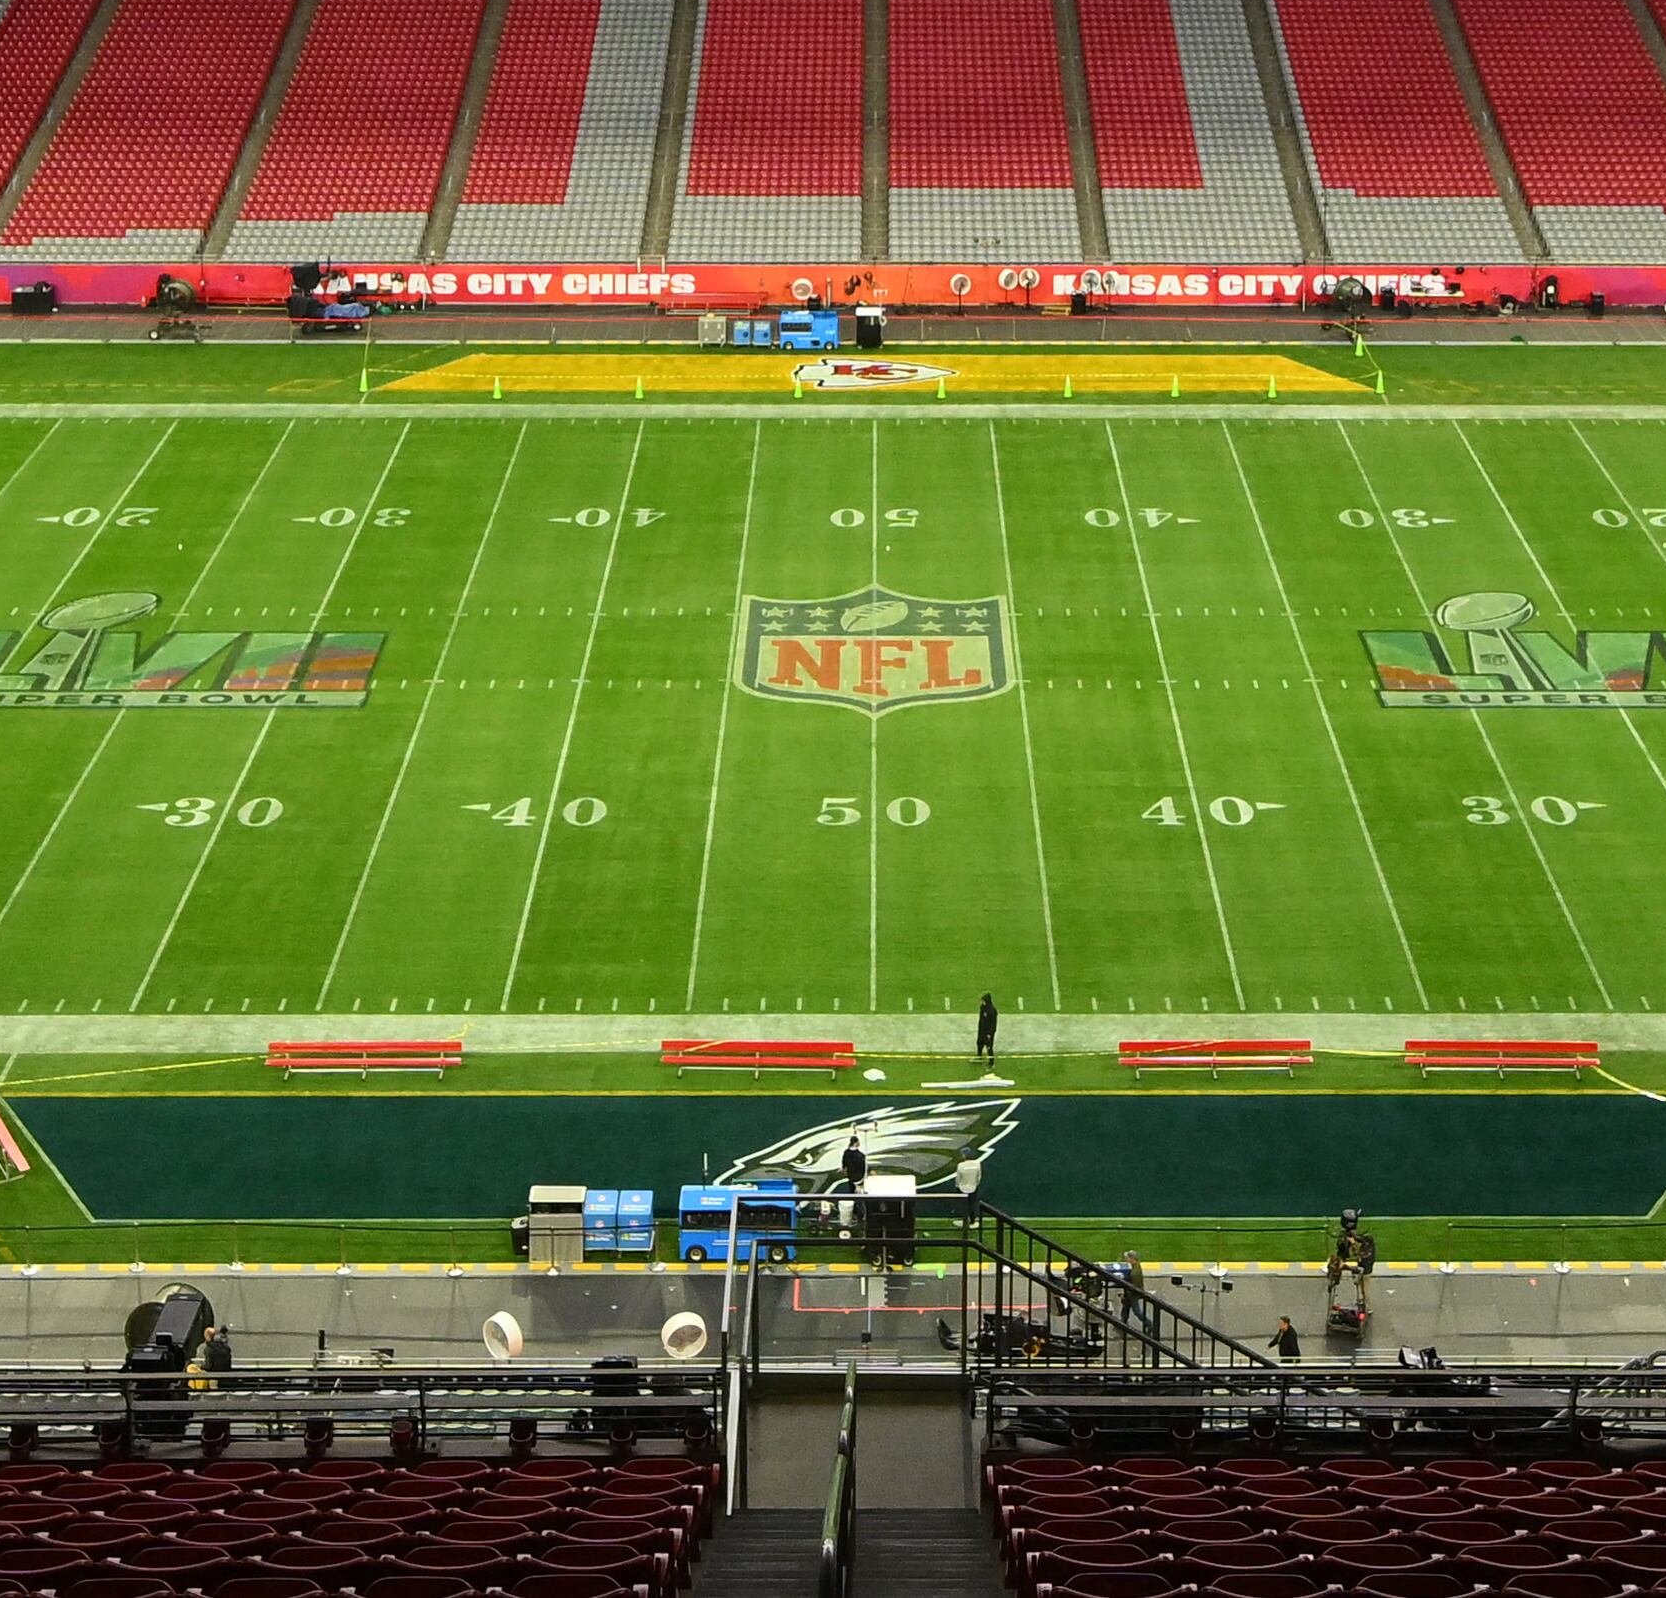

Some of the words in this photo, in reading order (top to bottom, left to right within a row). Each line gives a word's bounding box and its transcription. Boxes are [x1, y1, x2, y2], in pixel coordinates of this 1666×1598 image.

[312, 273, 458, 295] ANSAS
[467, 273, 553, 295] CITY
[562, 273, 696, 295] CHIEFS
[1218, 274, 1304, 296] CITY
[767, 639, 983, 697] NFL
[152, 693, 321, 705] BOWL
[1422, 693, 1608, 705] SUPER
[164, 796, 284, 827] 30
[491, 796, 607, 827] 40
[816, 796, 931, 827] 50
[1141, 795, 1255, 826] 40
[1462, 795, 1581, 826] 30
